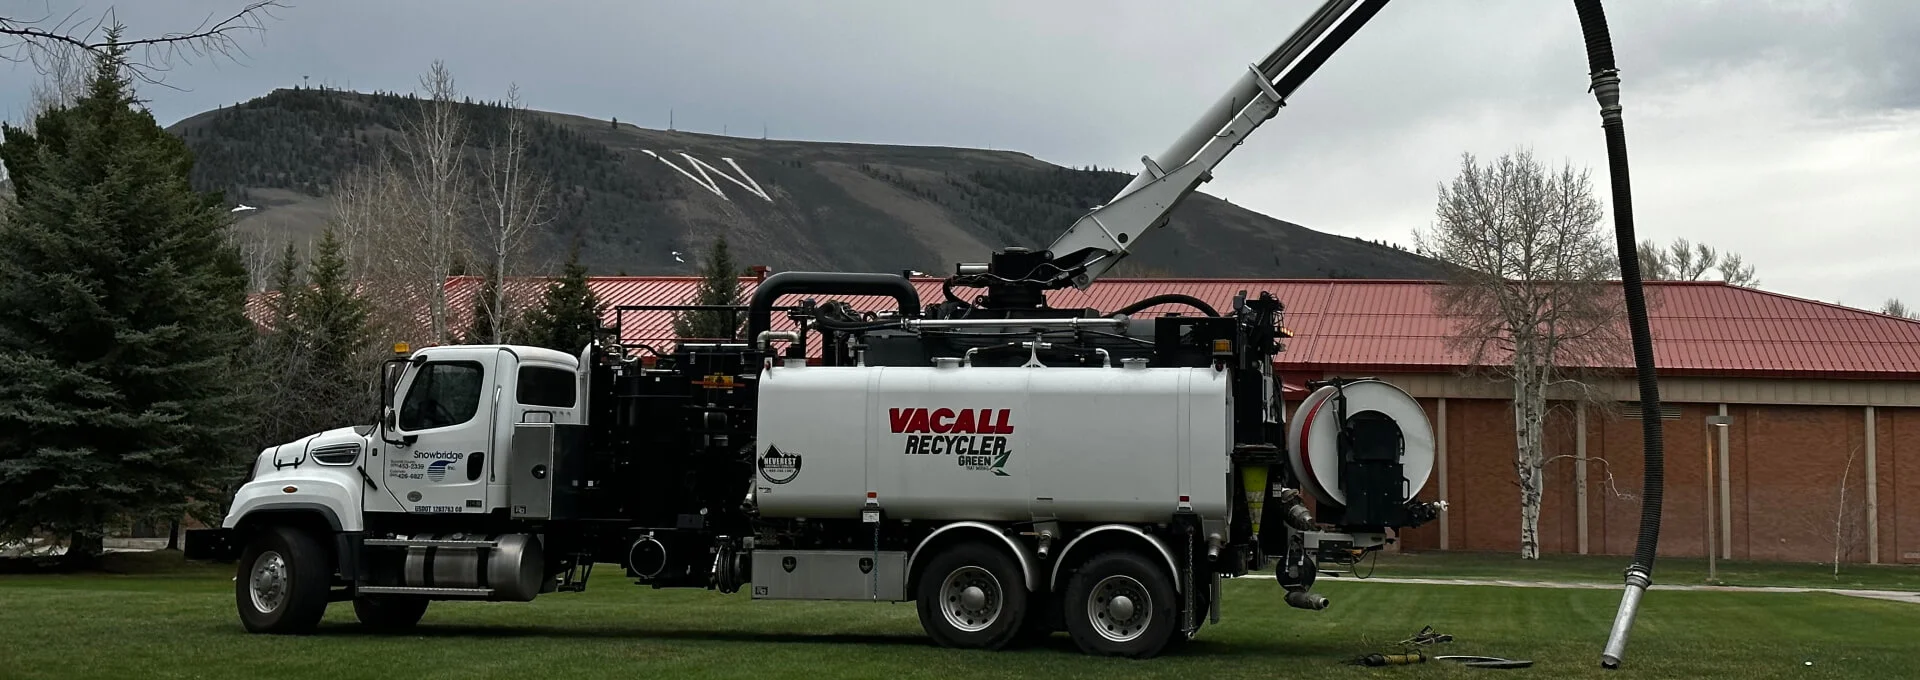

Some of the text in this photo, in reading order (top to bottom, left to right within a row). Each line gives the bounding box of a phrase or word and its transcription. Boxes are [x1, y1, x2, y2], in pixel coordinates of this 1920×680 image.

[889, 408, 1015, 434] VACALL
[905, 435, 1008, 455] RECYCLER
[414, 450, 464, 460] Snowbridge
[958, 455, 991, 467] GREEN
